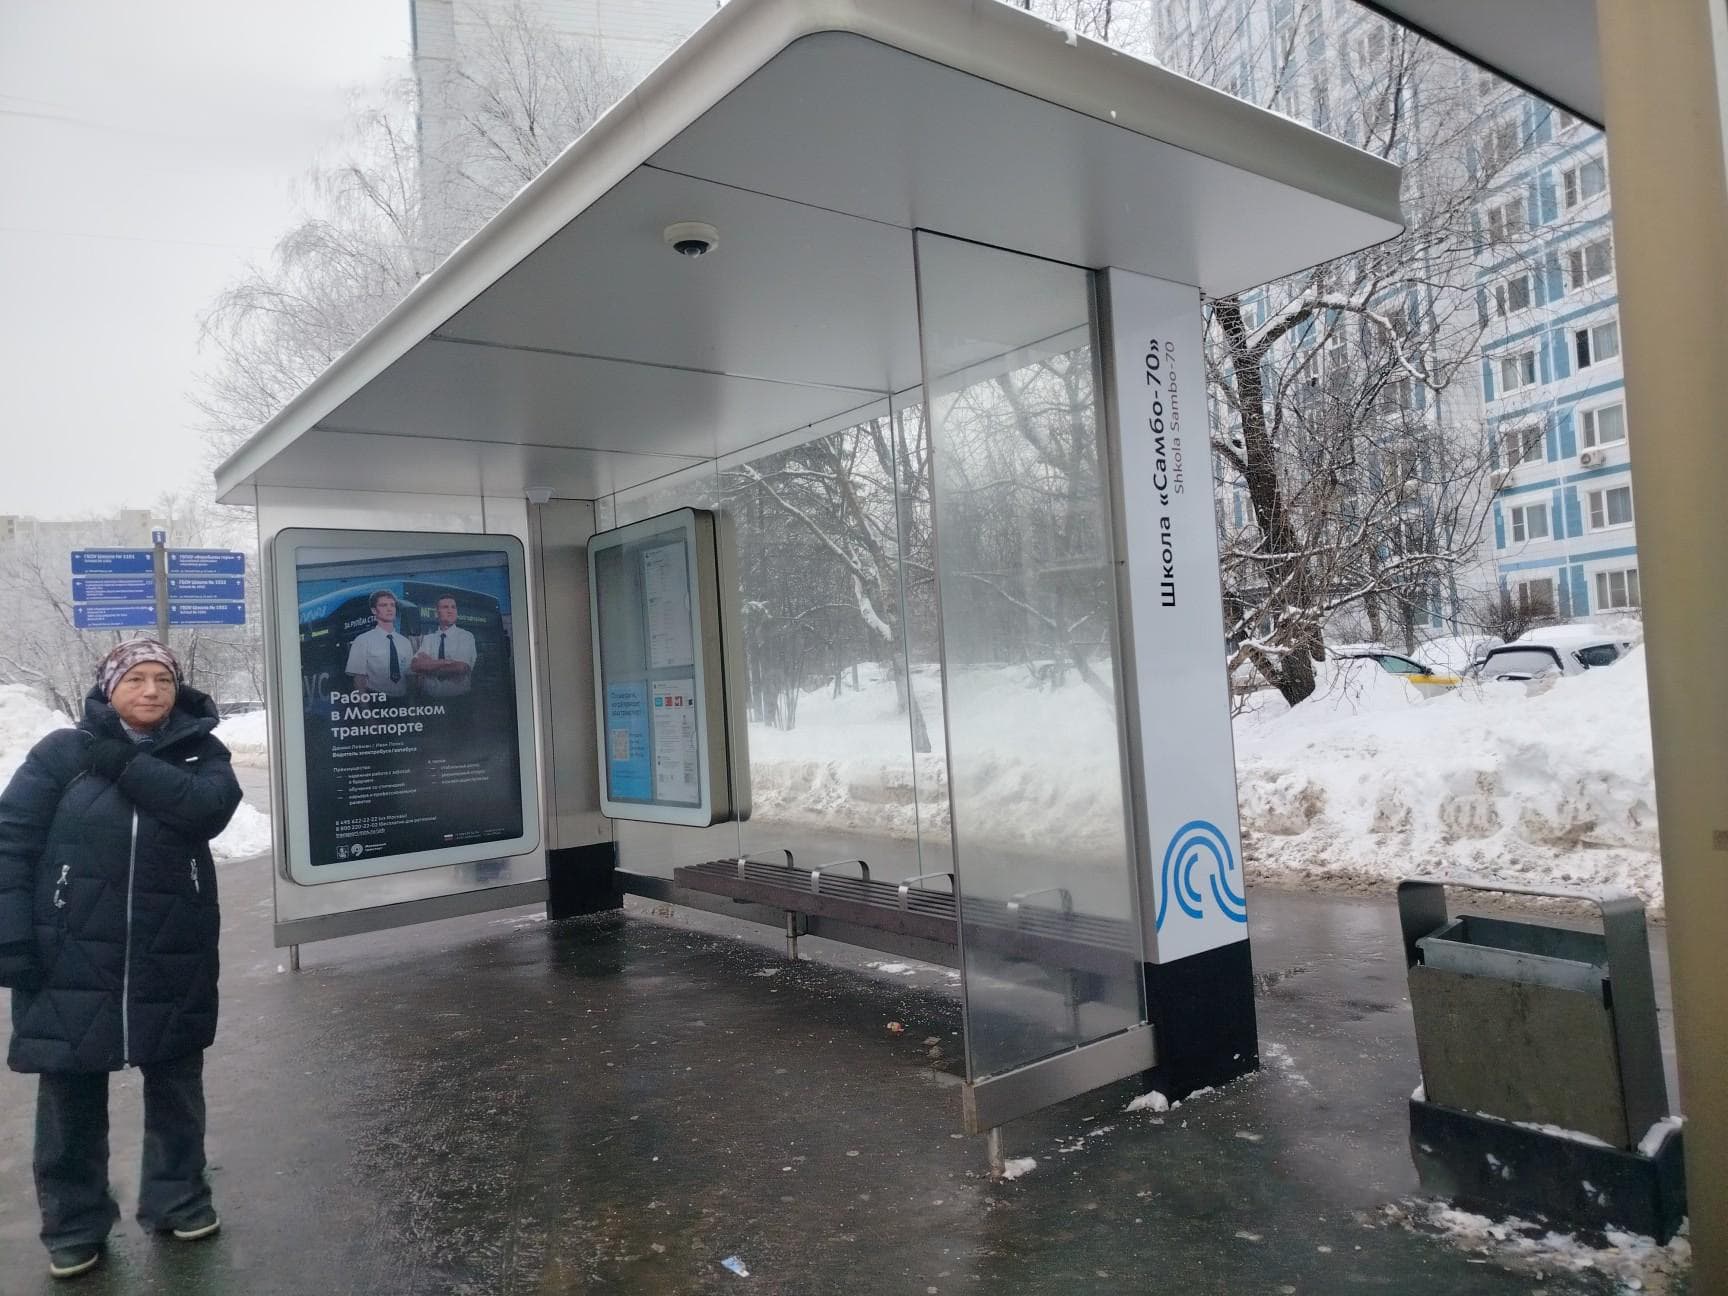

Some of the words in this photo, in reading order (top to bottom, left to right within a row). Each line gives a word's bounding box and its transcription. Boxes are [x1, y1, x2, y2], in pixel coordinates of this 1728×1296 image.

[1165, 341, 1180, 432] Sambo-70
[1145, 338, 1169, 506] «Самбо-70»
[1171, 437, 1184, 494] Shkola
[1159, 516, 1176, 607] Школа
[330, 690, 387, 705] Работа
[331, 711, 340, 721] в
[344, 705, 446, 720] Московском
[331, 722, 424, 740] транспорте
